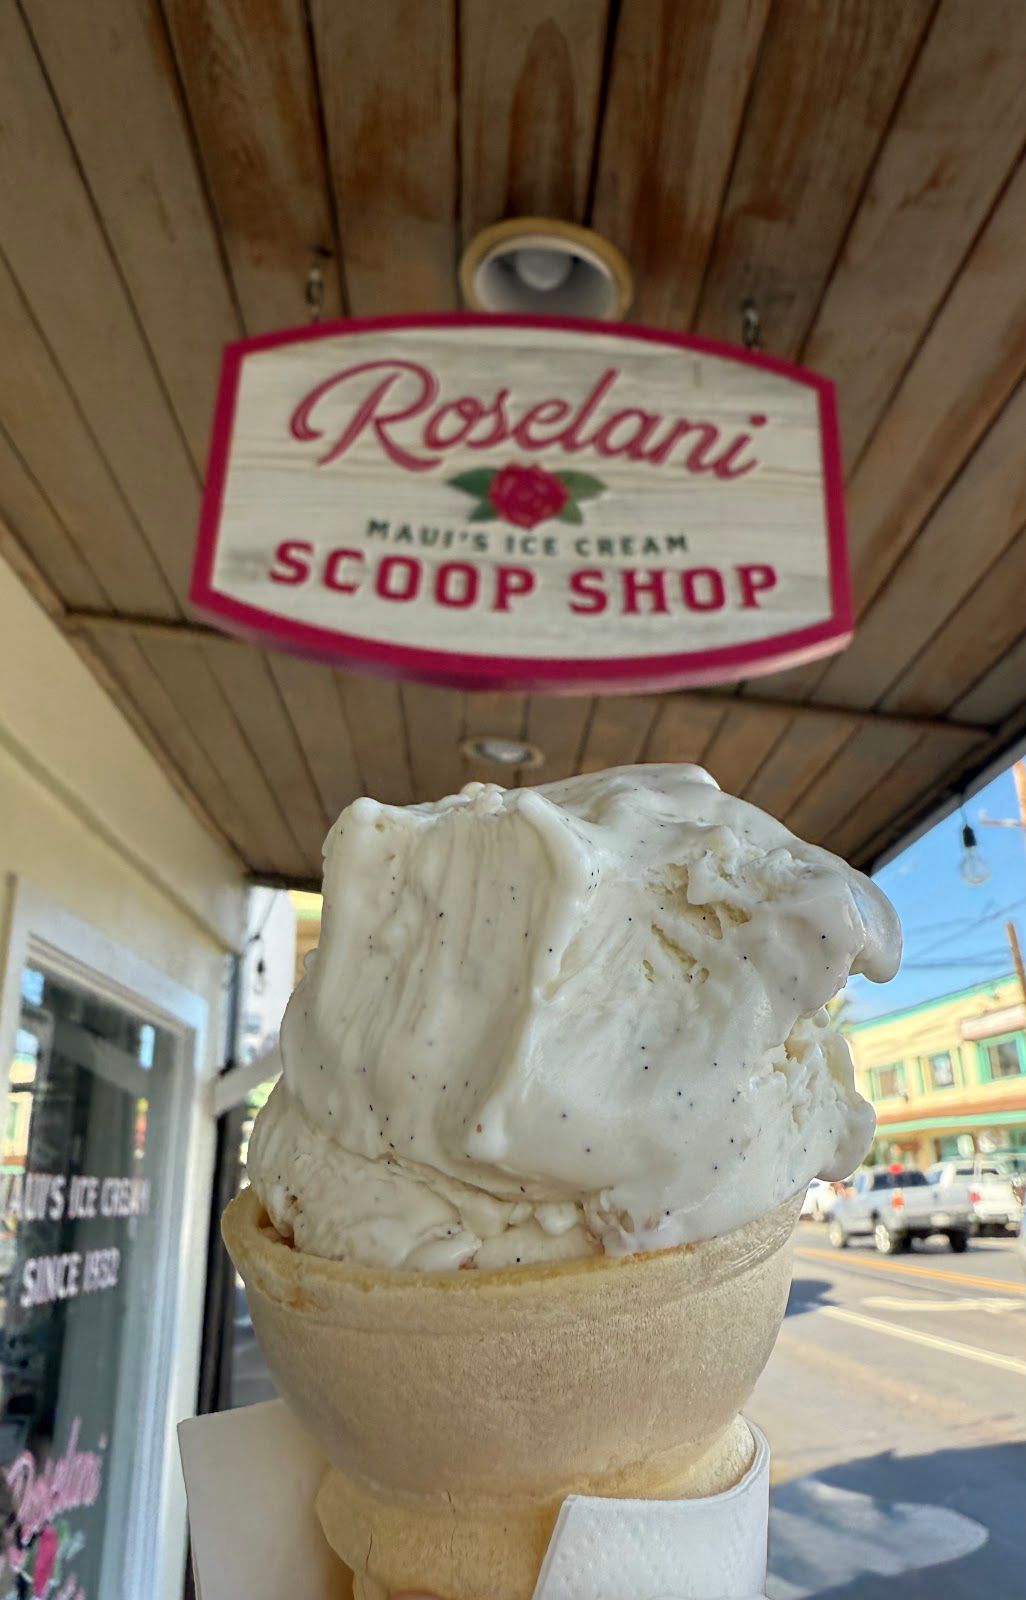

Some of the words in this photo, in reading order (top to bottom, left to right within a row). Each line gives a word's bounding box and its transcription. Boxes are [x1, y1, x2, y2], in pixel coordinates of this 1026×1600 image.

[289, 359, 767, 480] Roselani
[366, 518, 489, 553] MAUI'S
[505, 535, 558, 557] ICE
[575, 532, 689, 557] CREAM
[269, 539, 537, 613] SCOOP
[568, 563, 778, 615] SHOP
[20, 1252, 82, 1309] SINCE
